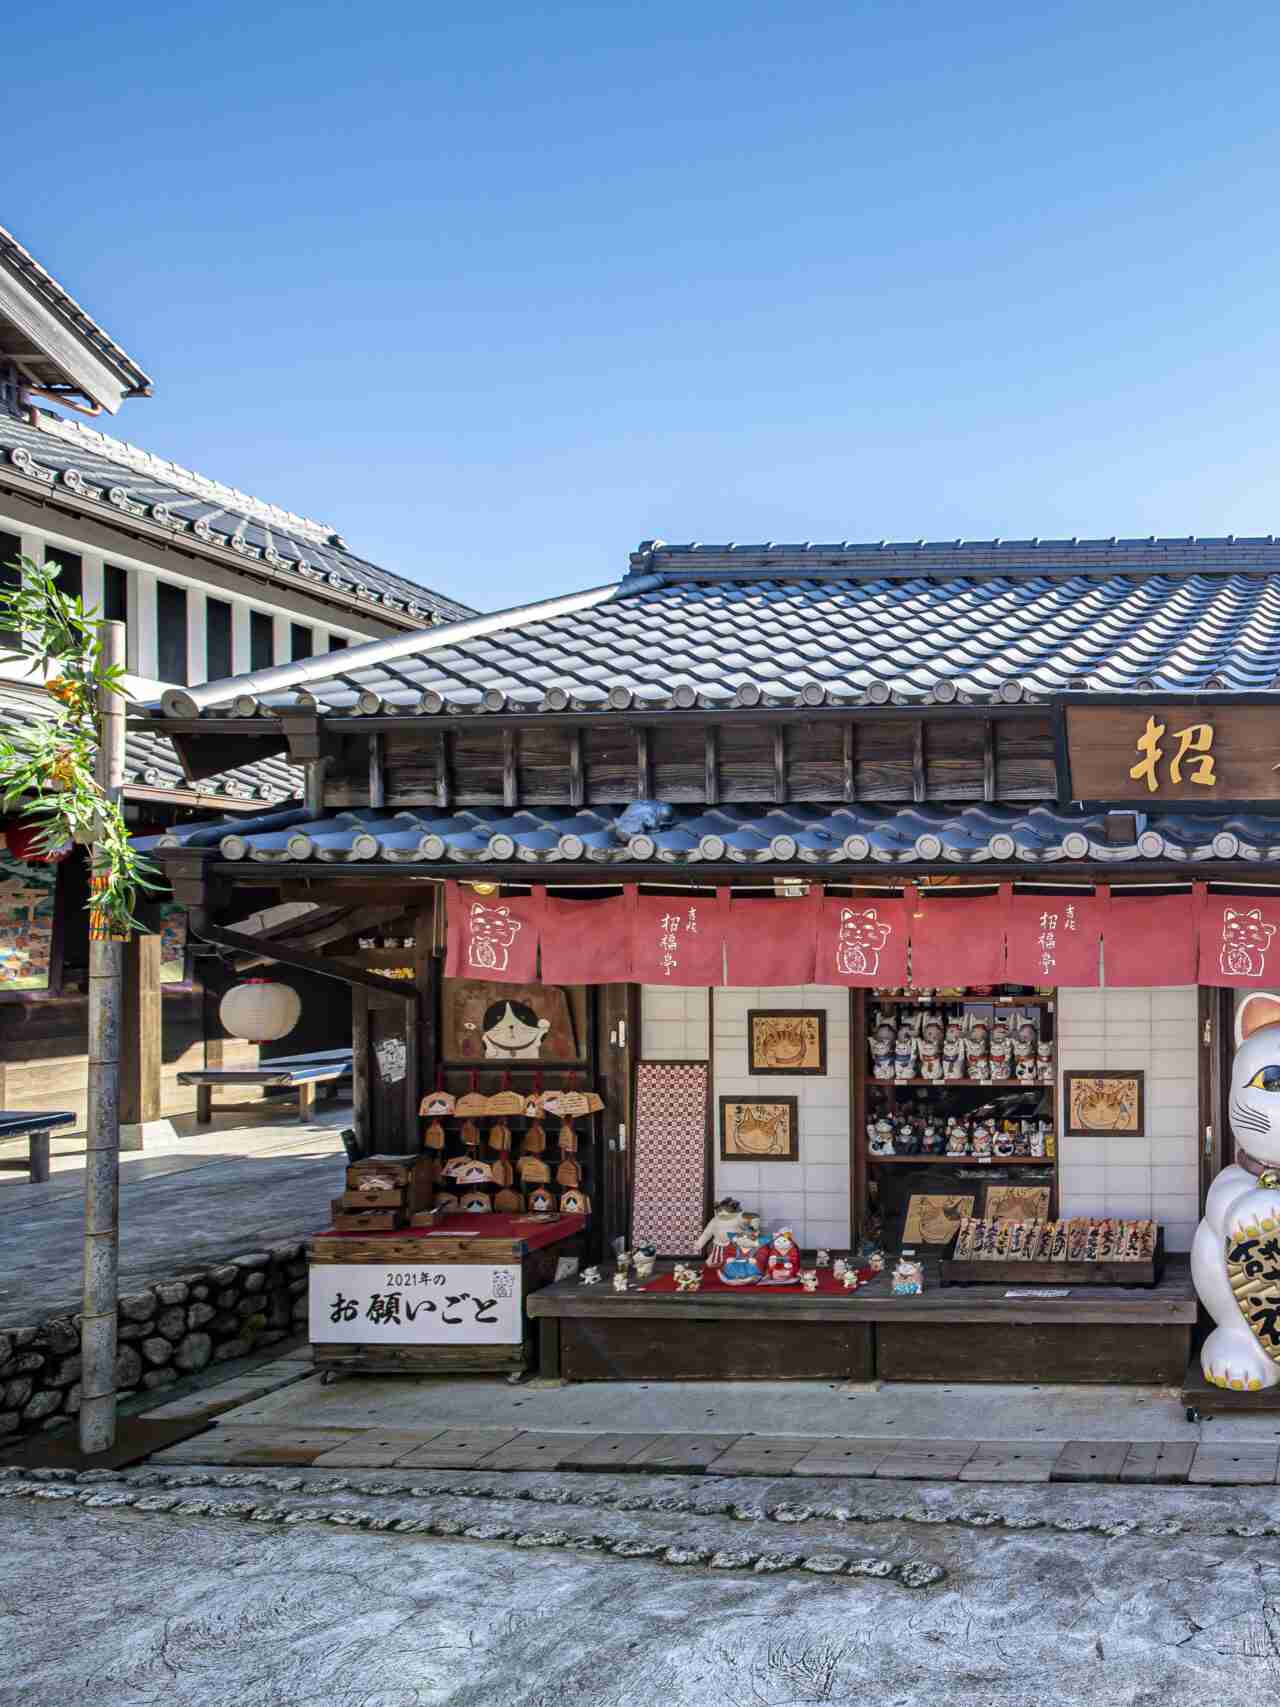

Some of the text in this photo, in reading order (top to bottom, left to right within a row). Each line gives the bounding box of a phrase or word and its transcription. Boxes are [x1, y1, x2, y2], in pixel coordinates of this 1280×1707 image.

[386, 1271, 446, 1287] 2021年の
[330, 1292, 499, 1325] お願いごと
